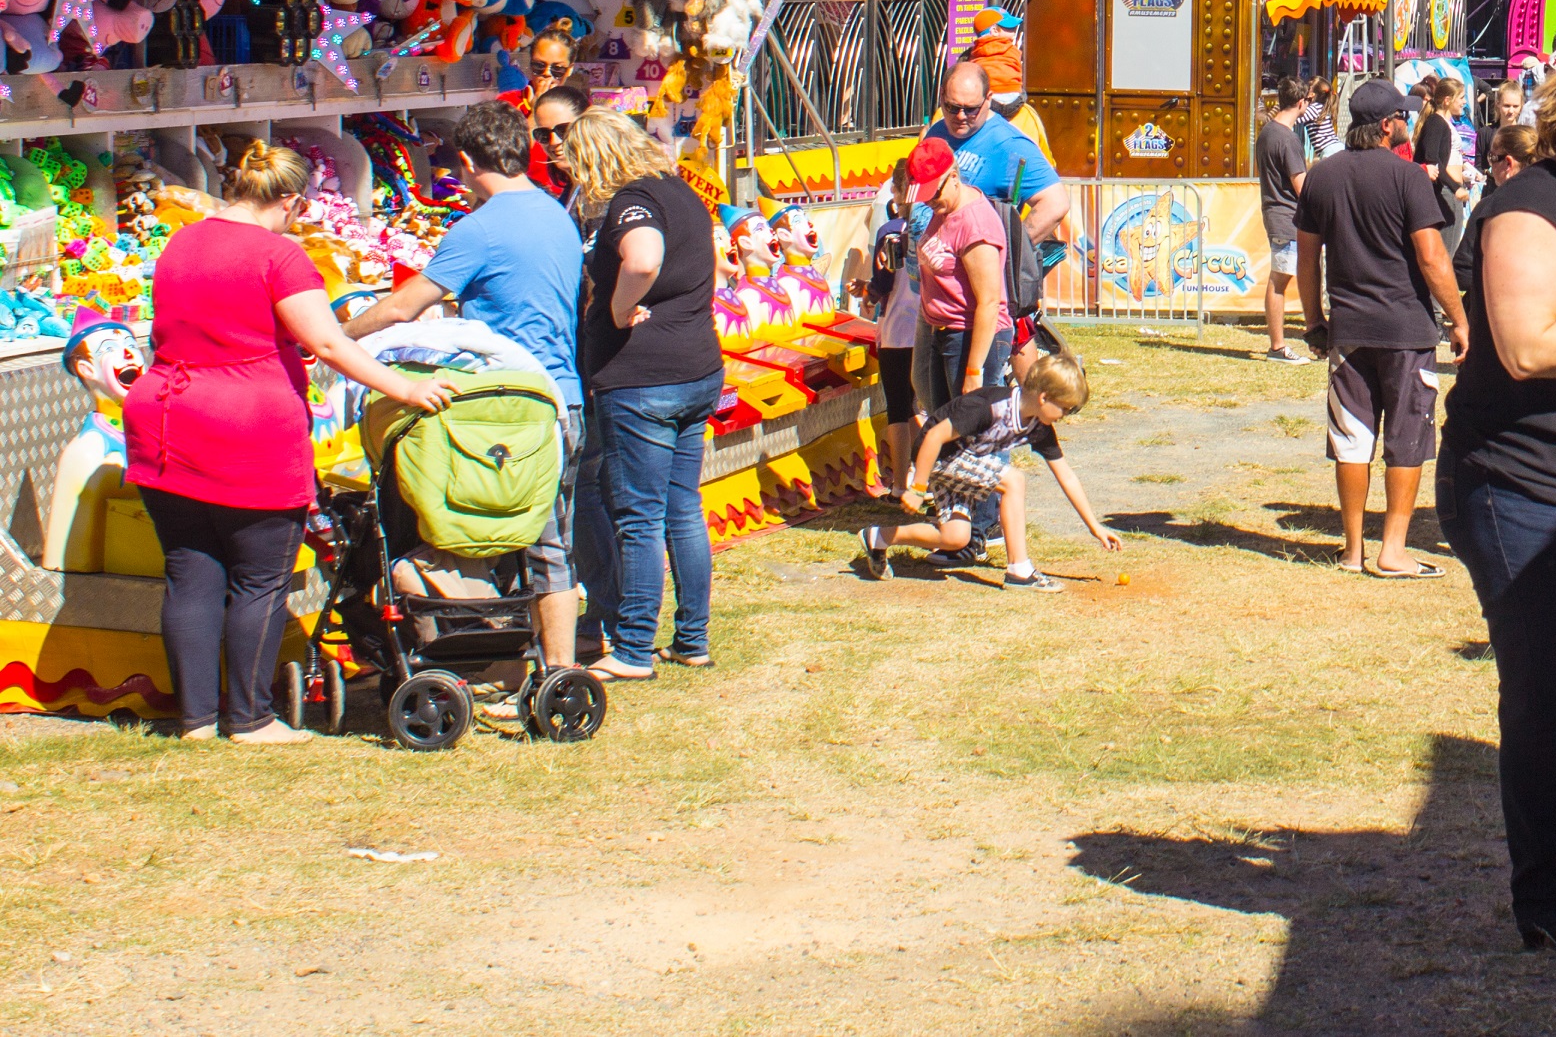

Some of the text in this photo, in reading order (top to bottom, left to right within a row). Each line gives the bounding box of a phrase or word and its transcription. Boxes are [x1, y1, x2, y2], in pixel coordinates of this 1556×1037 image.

[624, 10, 634, 24] 5
[608, 41, 619, 57] 8
[642, 65, 660, 80] 10
[1145, 124, 1154, 138] 2
[1133, 138, 1167, 150] FLAGS
[678, 164, 725, 202] EVERY
[1202, 284, 1230, 293] HOUSE
